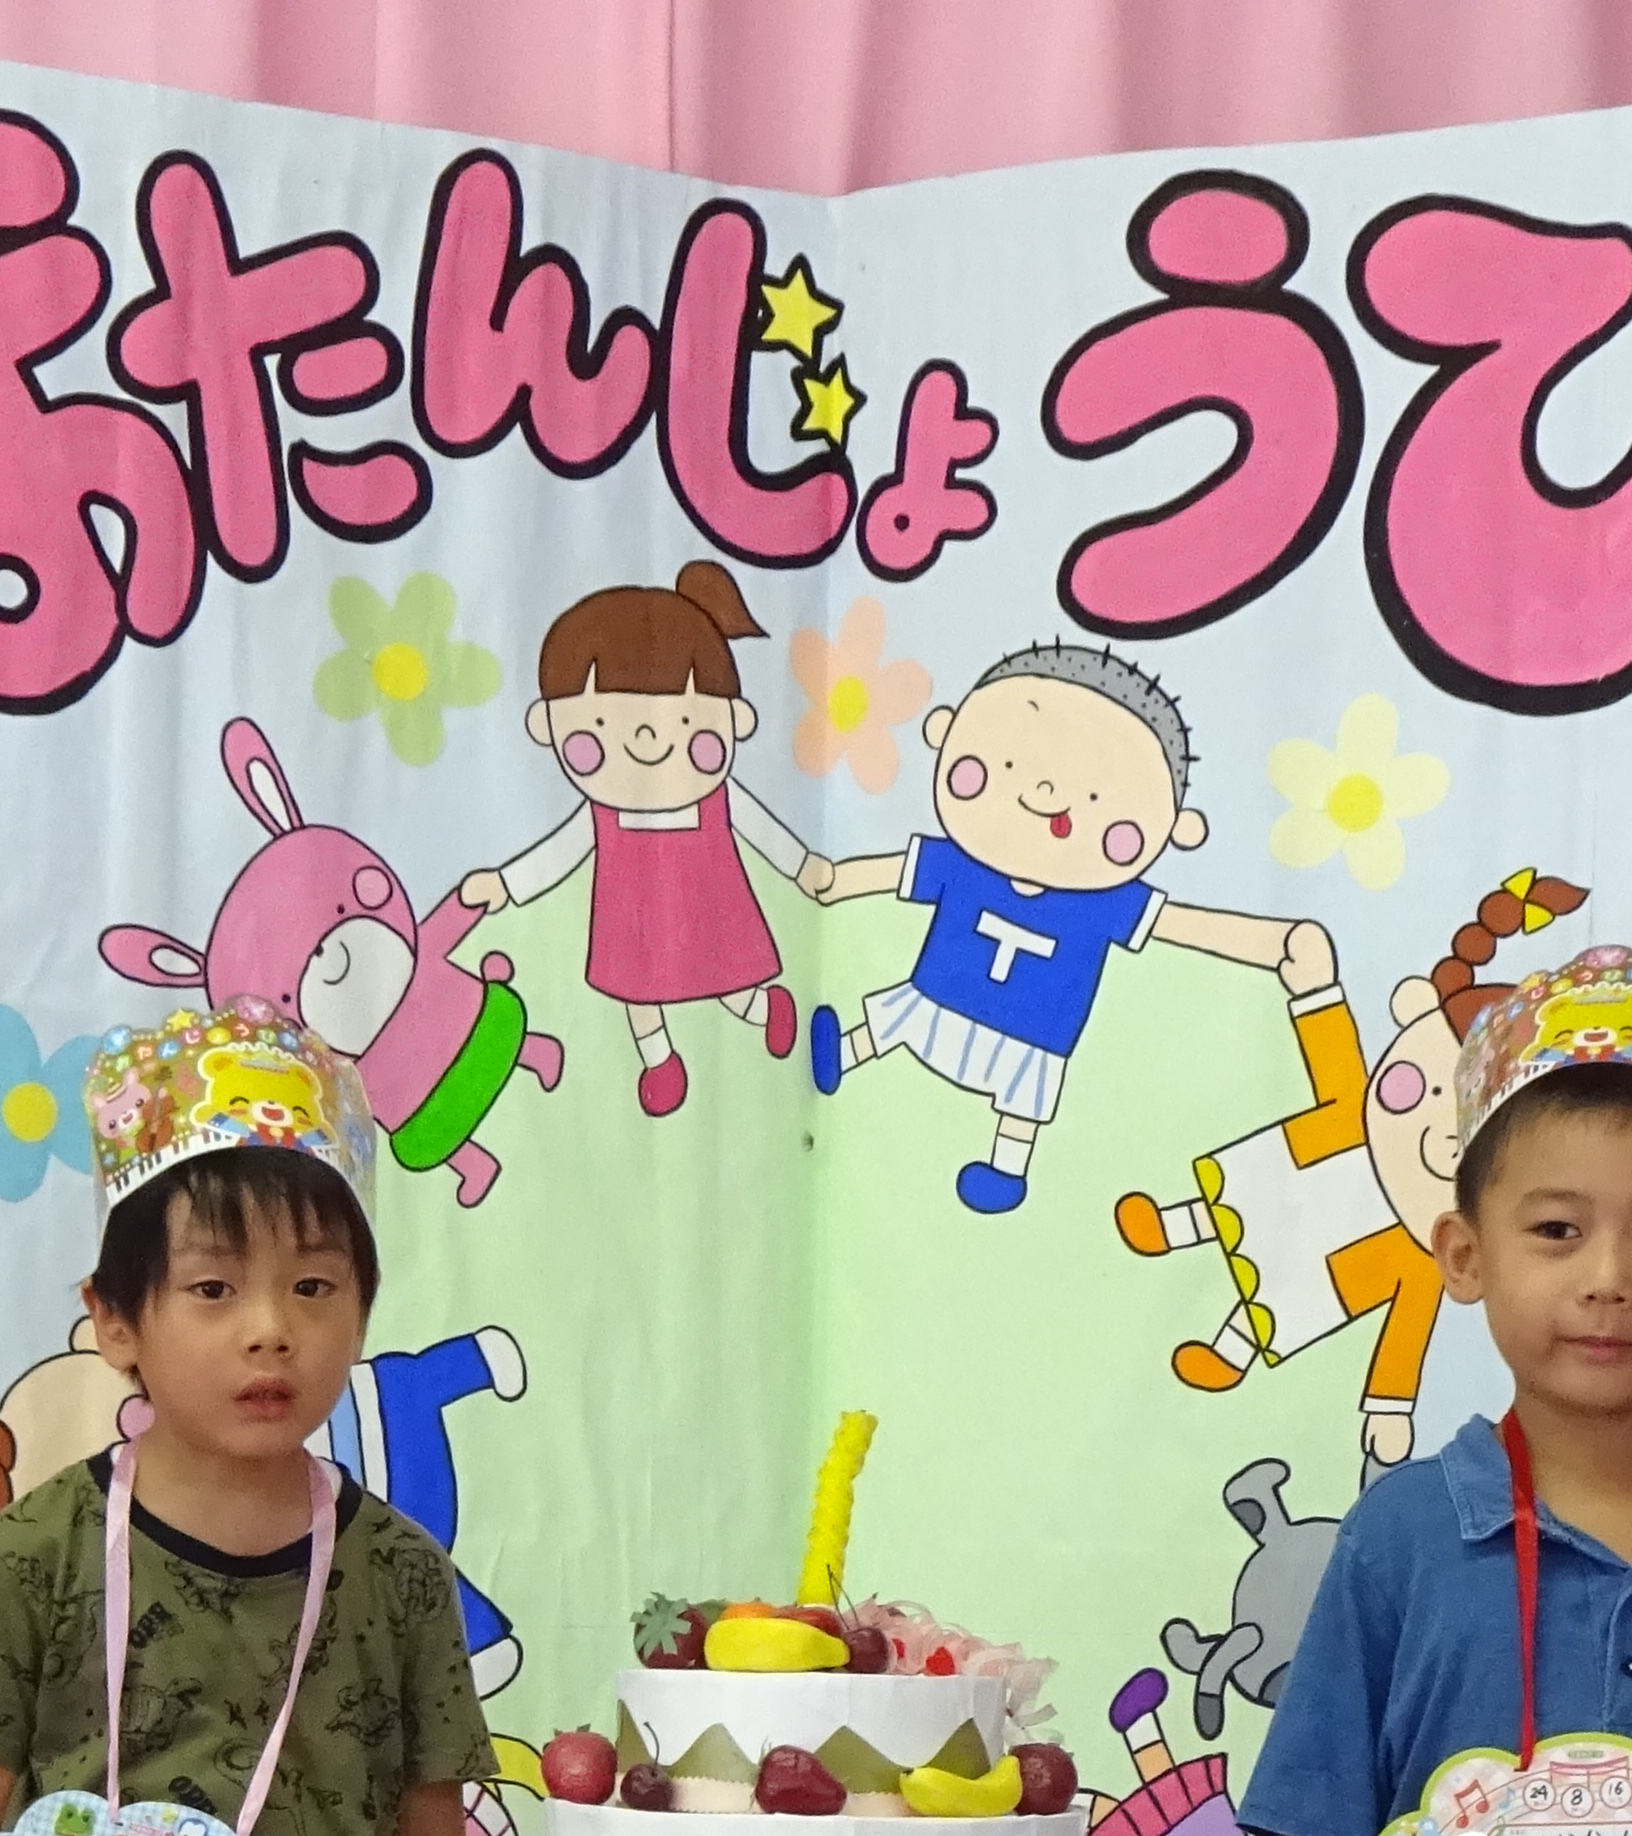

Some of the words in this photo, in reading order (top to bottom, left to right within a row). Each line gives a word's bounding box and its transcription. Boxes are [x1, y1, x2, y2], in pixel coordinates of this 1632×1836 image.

[975, 913, 1056, 983] T
[1529, 1785, 1548, 1801] 24
[1570, 1789, 1583, 1806] 8
[1607, 1781, 1623, 1796] 16
